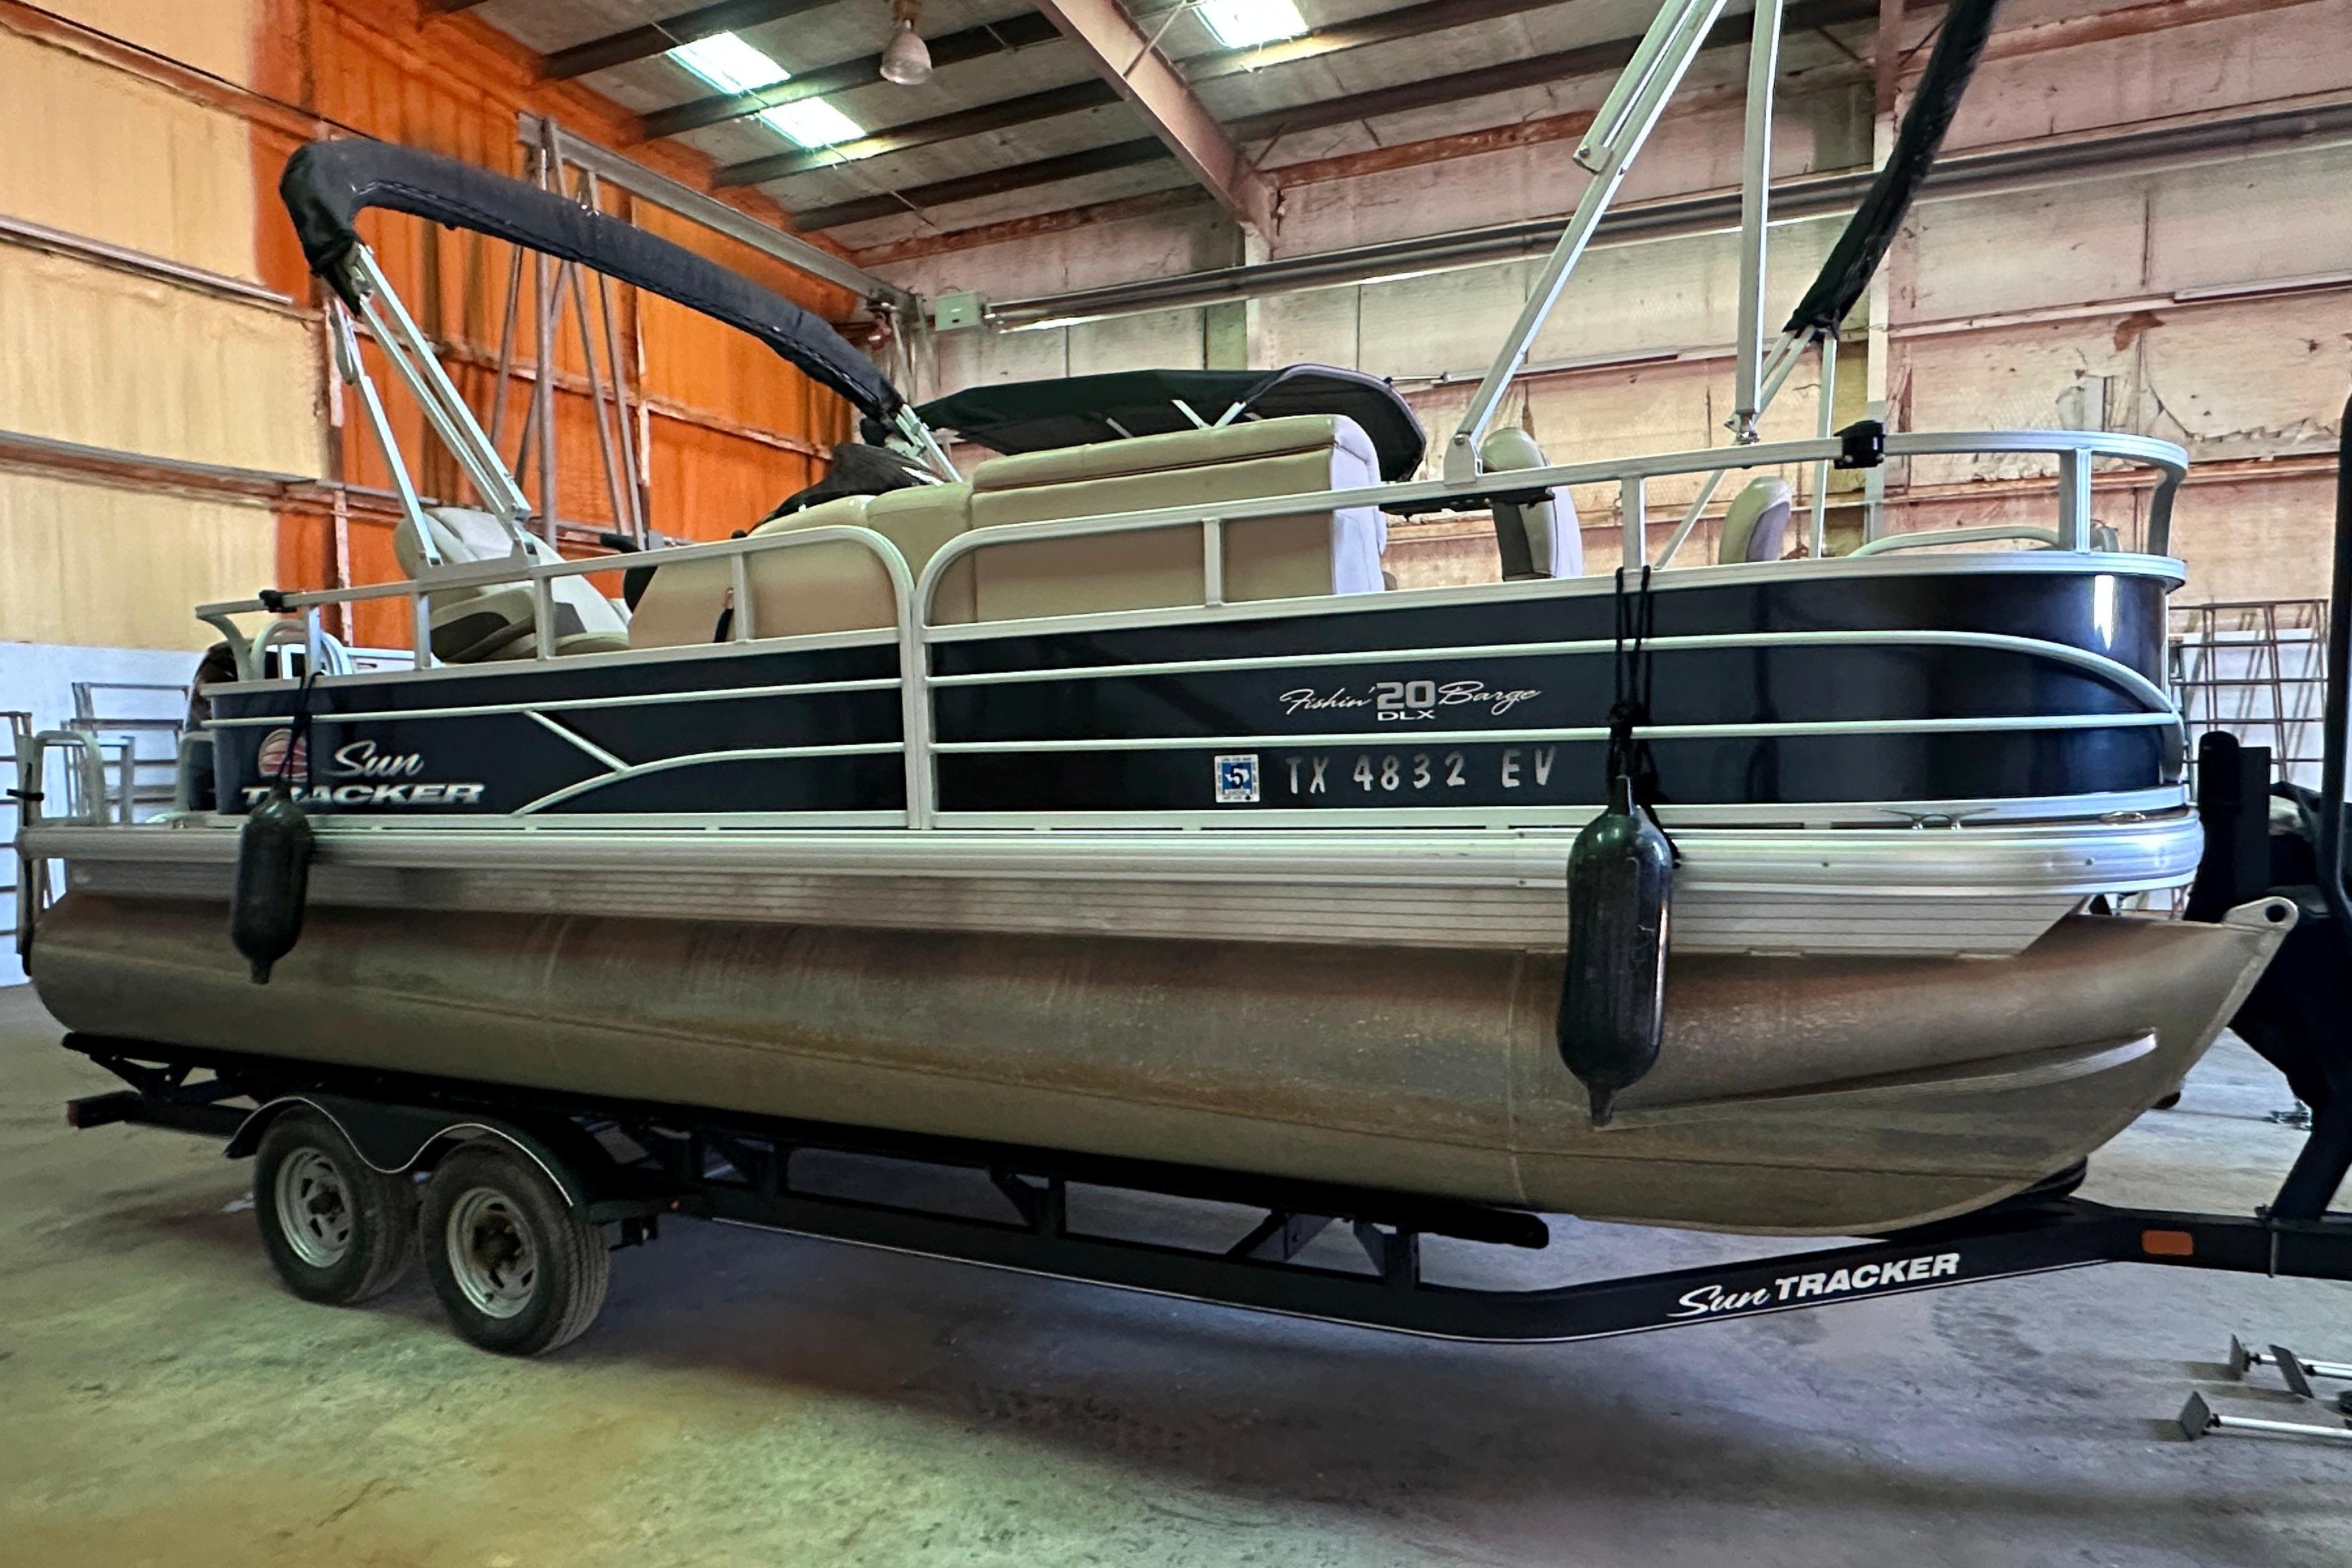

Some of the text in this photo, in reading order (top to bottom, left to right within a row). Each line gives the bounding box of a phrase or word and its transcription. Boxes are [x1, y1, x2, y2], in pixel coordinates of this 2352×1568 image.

[1279, 680, 1542, 716] Fishin' 20 Barge
[1377, 710, 1435, 721] DLX
[321, 740, 425, 777] Sun
[1285, 756, 1328, 794] TX
[1353, 750, 1466, 792] 4832
[1502, 745, 1557, 788] EV
[1667, 1252, 1960, 1318] Sun TRACKER
